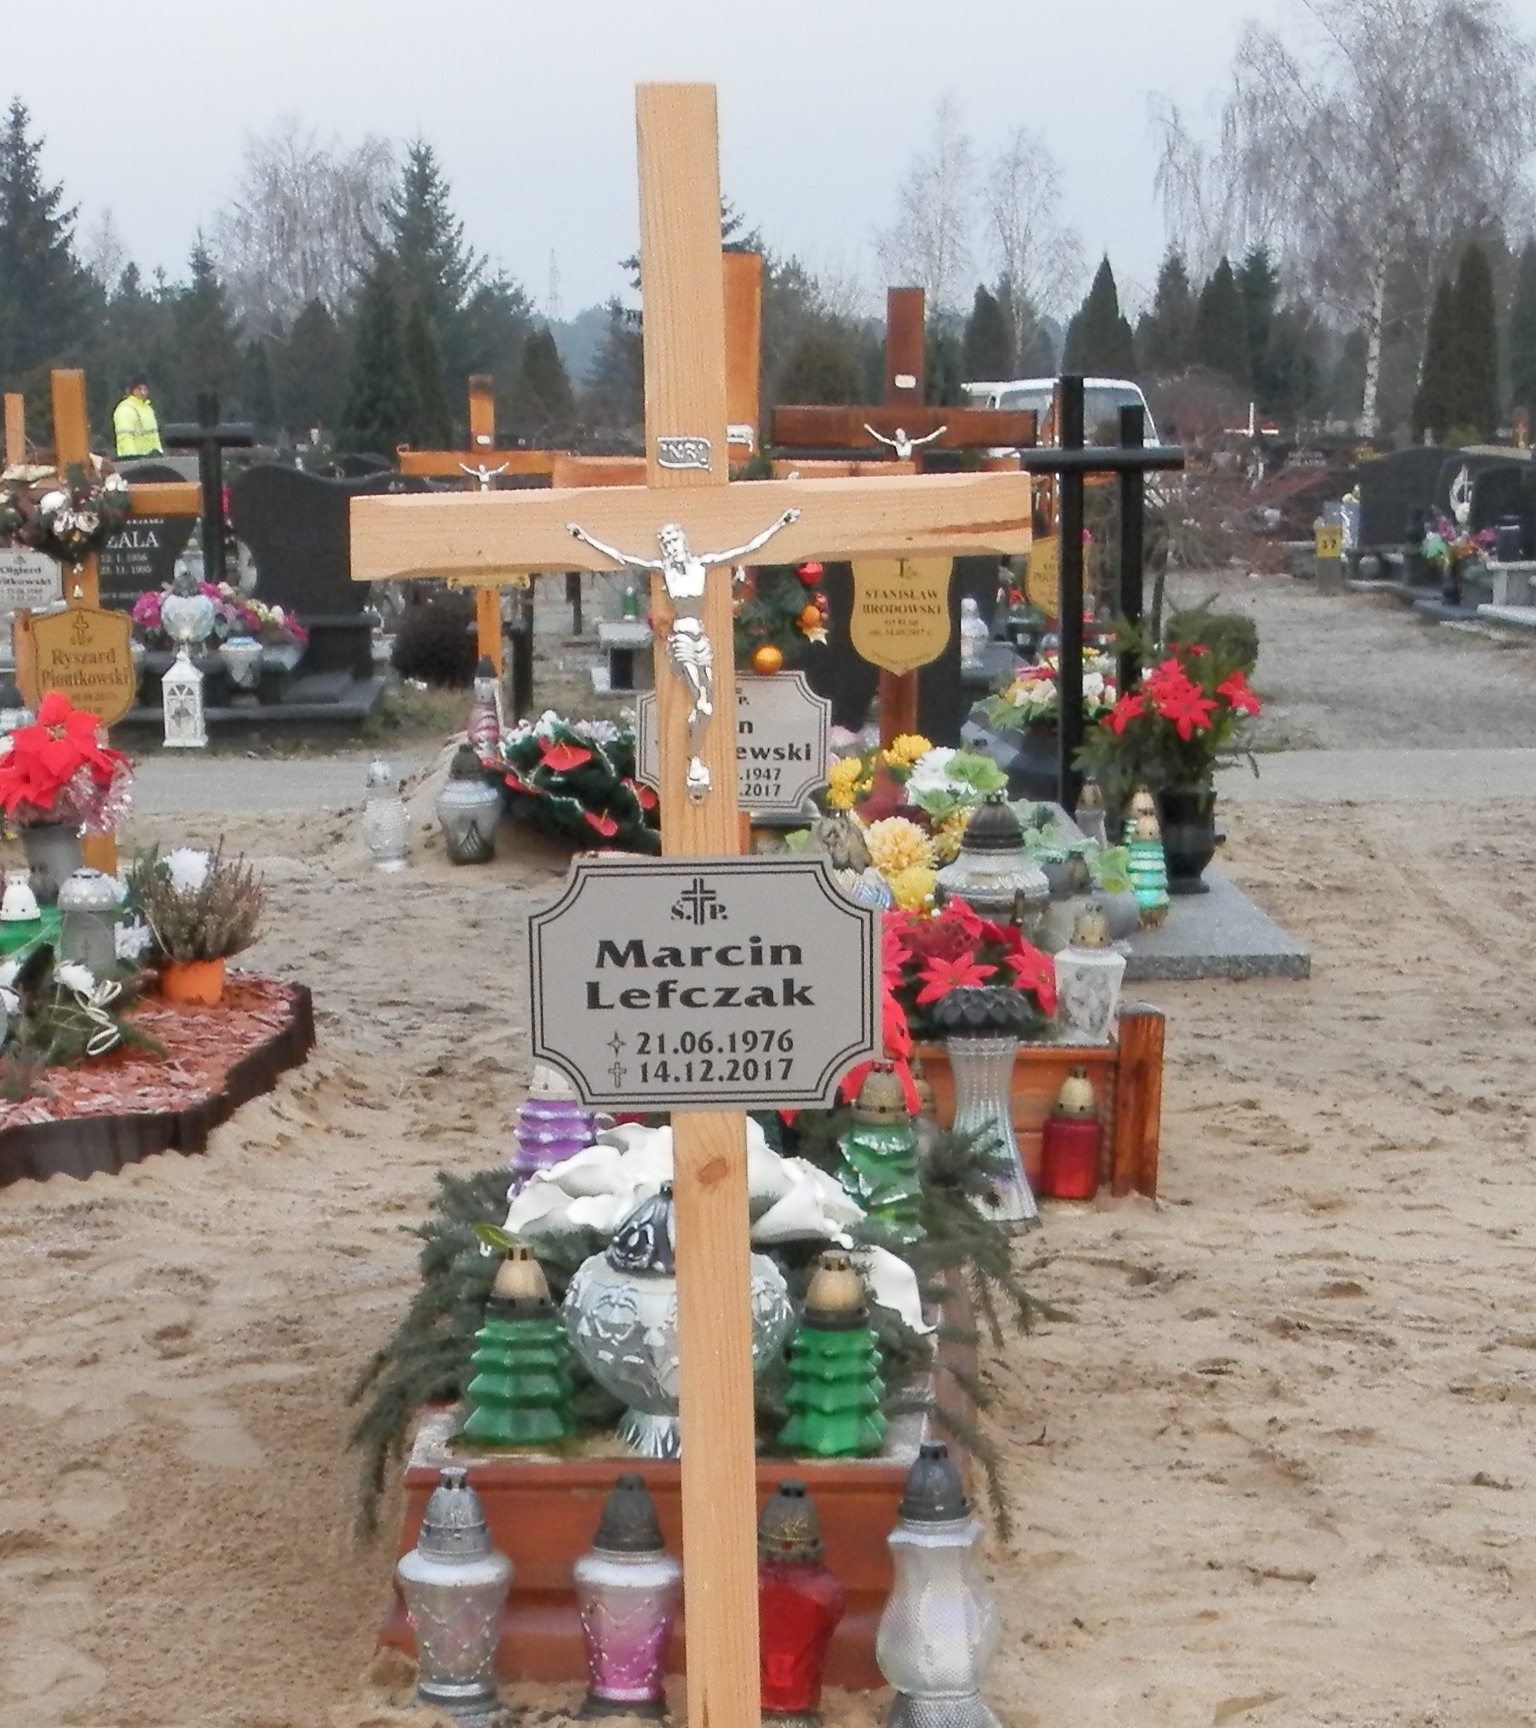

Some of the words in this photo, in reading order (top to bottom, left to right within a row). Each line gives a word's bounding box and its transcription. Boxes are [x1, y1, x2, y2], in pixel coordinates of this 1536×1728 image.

[865, 589, 938, 600] STANISŁAW
[862, 604, 942, 615] BRODOWSKI
[52, 647, 116, 670] Ryszard
[595, 935, 803, 969] Marcin
[586, 978, 816, 1010] Lefczak
[636, 1028, 795, 1055] 21.06.1976
[640, 1058, 795, 1083] 14.12.2017
